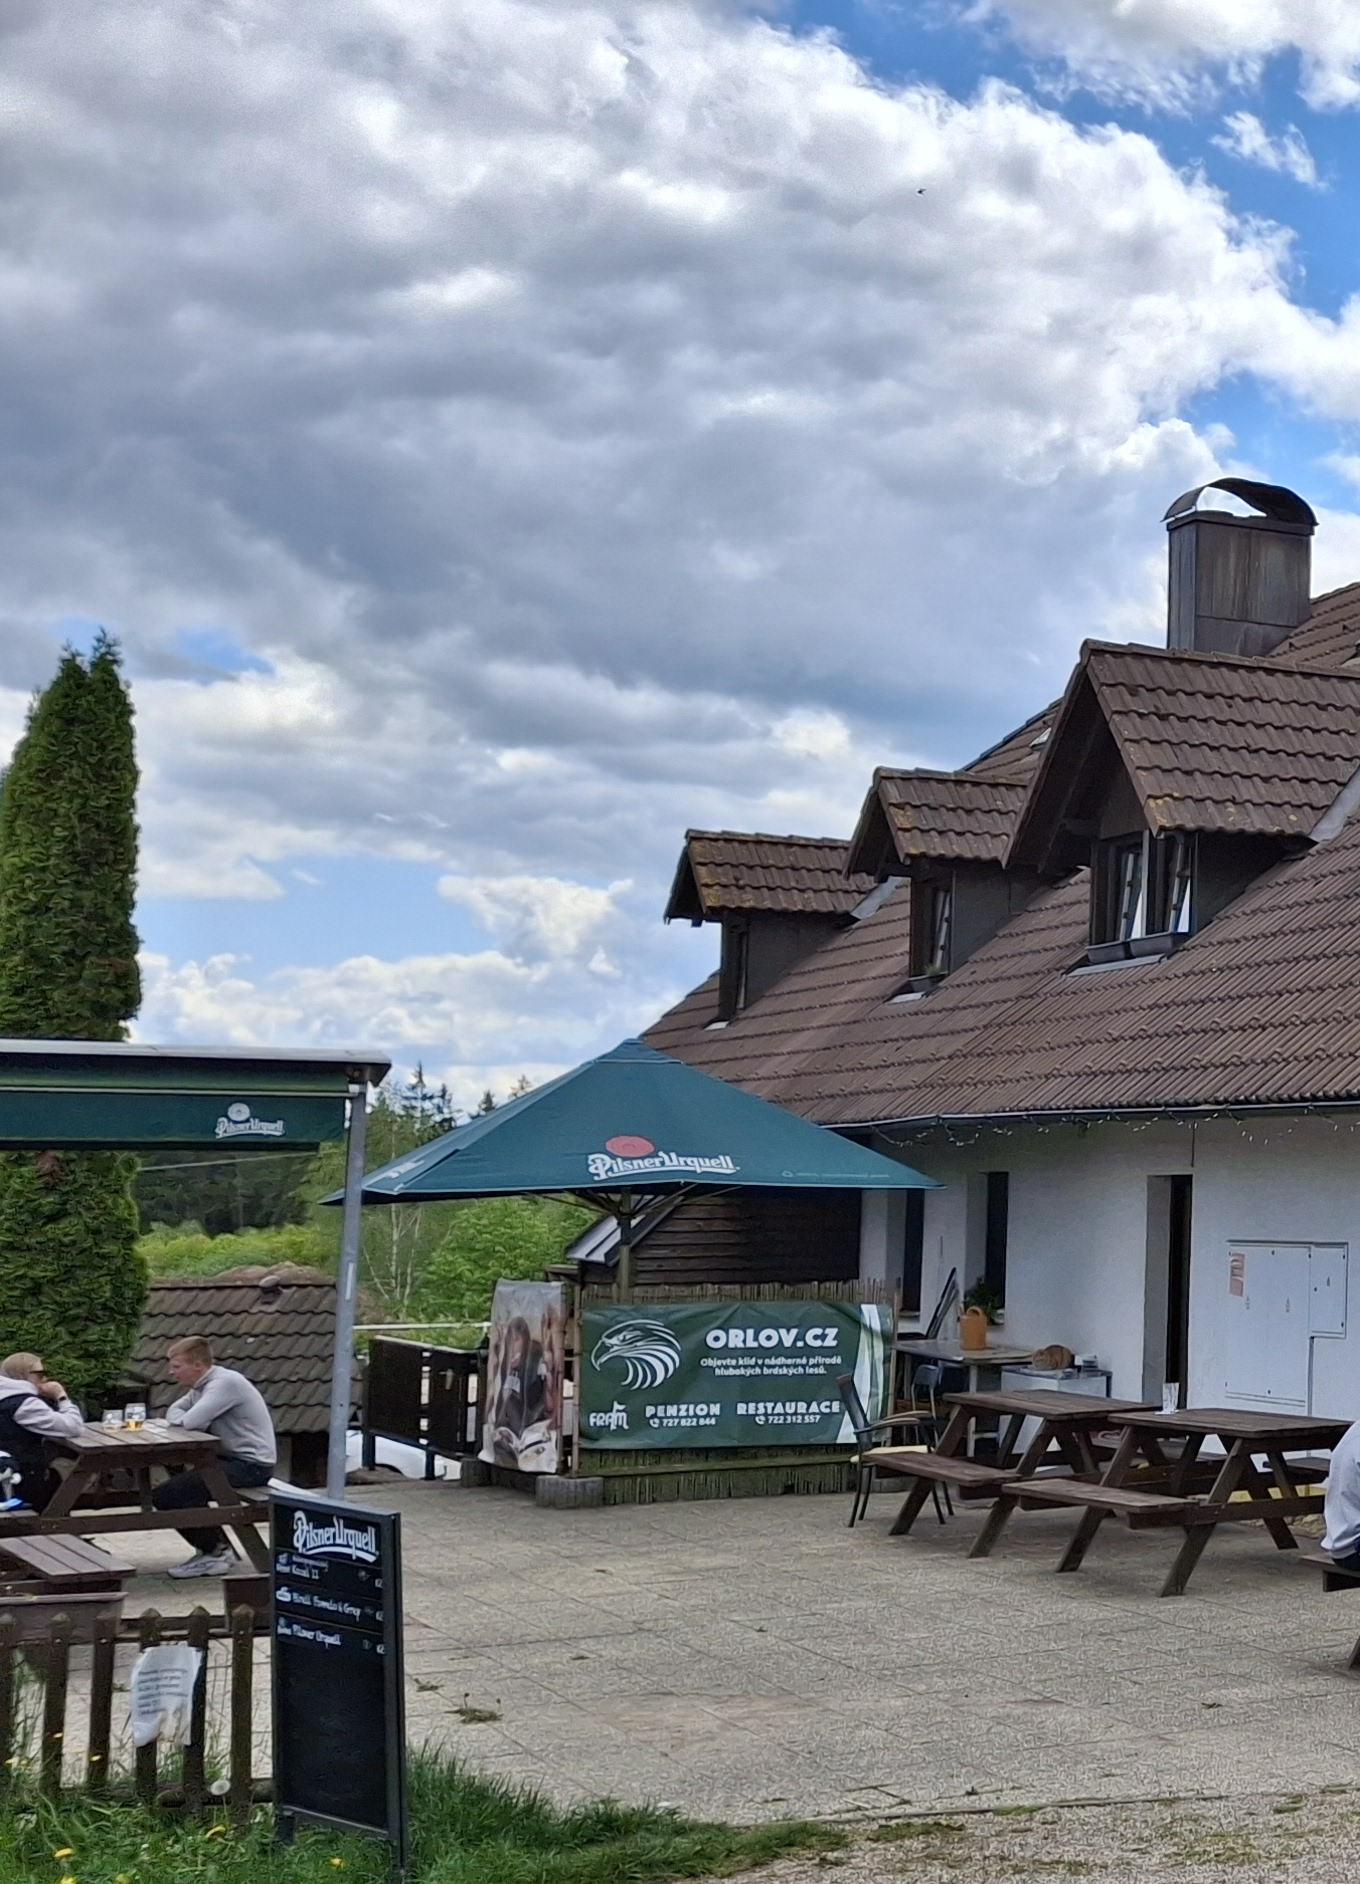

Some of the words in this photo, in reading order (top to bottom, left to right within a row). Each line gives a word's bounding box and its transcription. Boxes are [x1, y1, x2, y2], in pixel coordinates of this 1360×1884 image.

[214, 1117, 251, 1139] Pilsner
[249, 1117, 284, 1135] Urquell
[588, 1151, 663, 1180] Pilsner
[658, 1151, 733, 1174] Urquell
[705, 1327, 839, 1349] ORLOV.CZ
[700, 1358, 736, 1368] Objevte
[738, 1357, 756, 1366] klid
[764, 1356, 807, 1365] nádherné
[715, 1367, 761, 1376] hlubokých
[763, 1366, 804, 1376] brdských
[806, 1366, 827, 1374] lesů.
[645, 1403, 720, 1417] PENZION
[736, 1401, 840, 1415] RESTAURACE
[662, 1418, 679, 1427] 727
[768, 1415, 783, 1424] 722
[786, 1415, 802, 1424] 312
[804, 1415, 821, 1424] 557
[293, 1510, 336, 1553] Pilsner
[333, 1515, 376, 1560] Urquell
